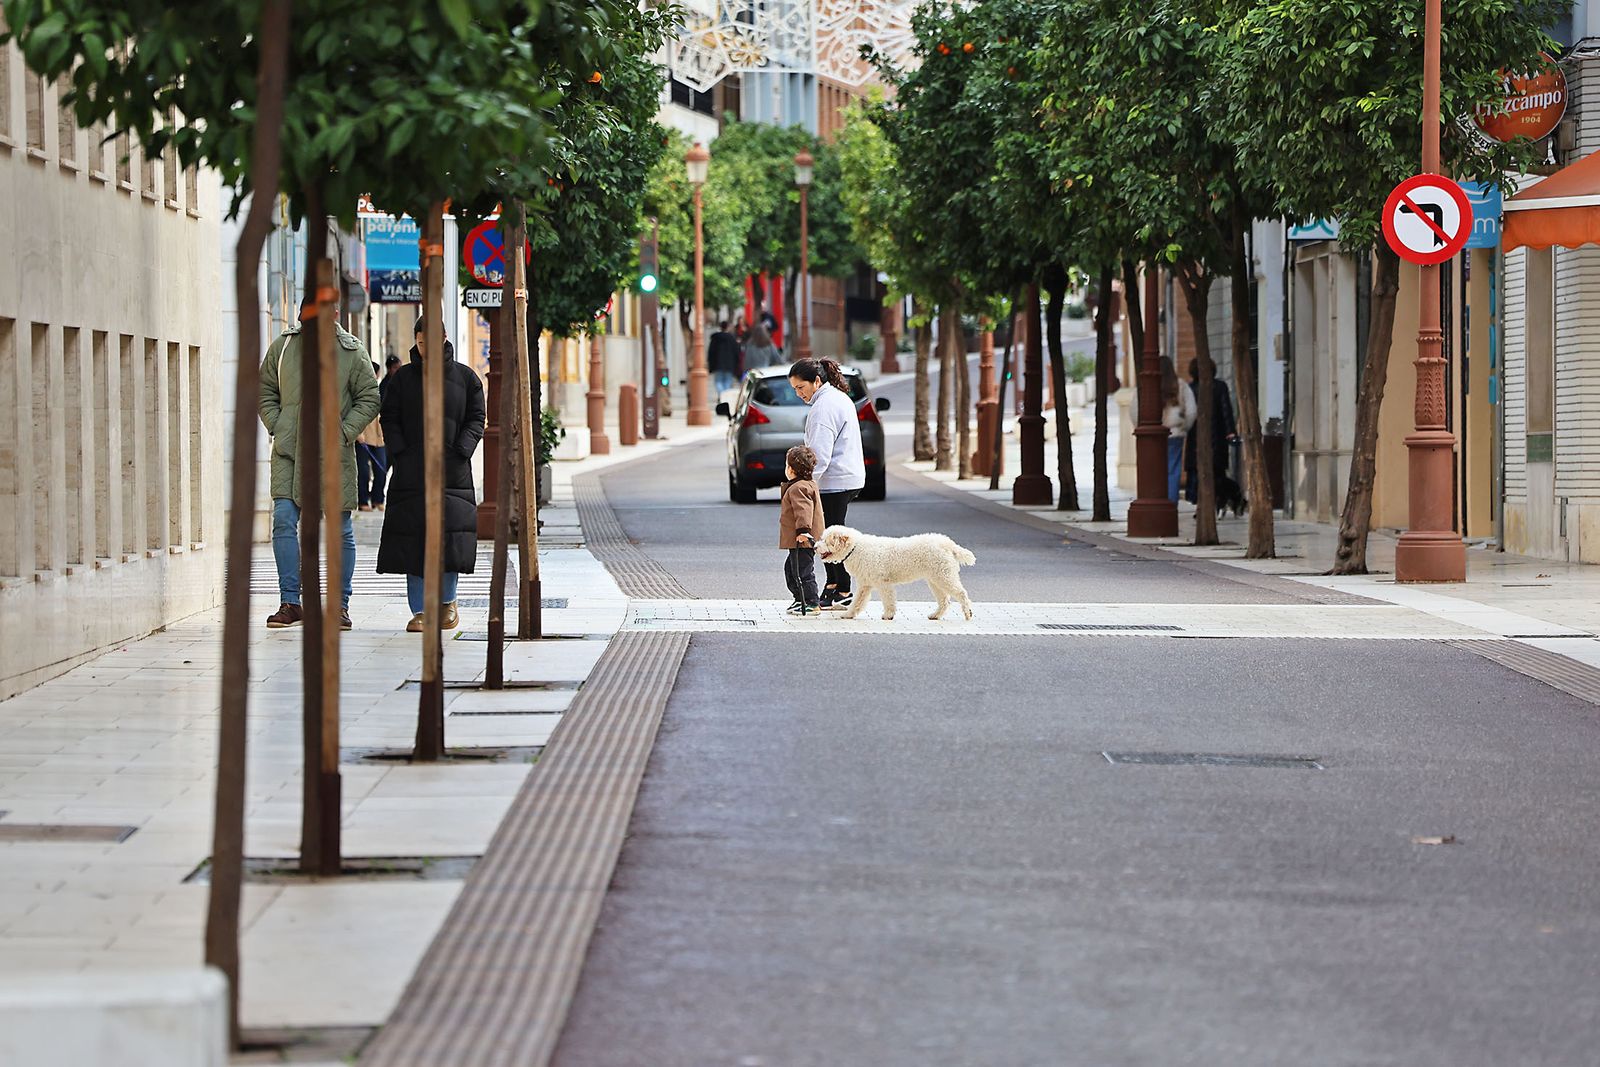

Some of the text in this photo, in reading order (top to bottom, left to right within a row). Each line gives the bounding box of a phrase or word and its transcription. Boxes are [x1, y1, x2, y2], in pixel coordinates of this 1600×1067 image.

[1521, 116, 1541, 124] 1904
[467, 292, 504, 304] EN C/ PU
